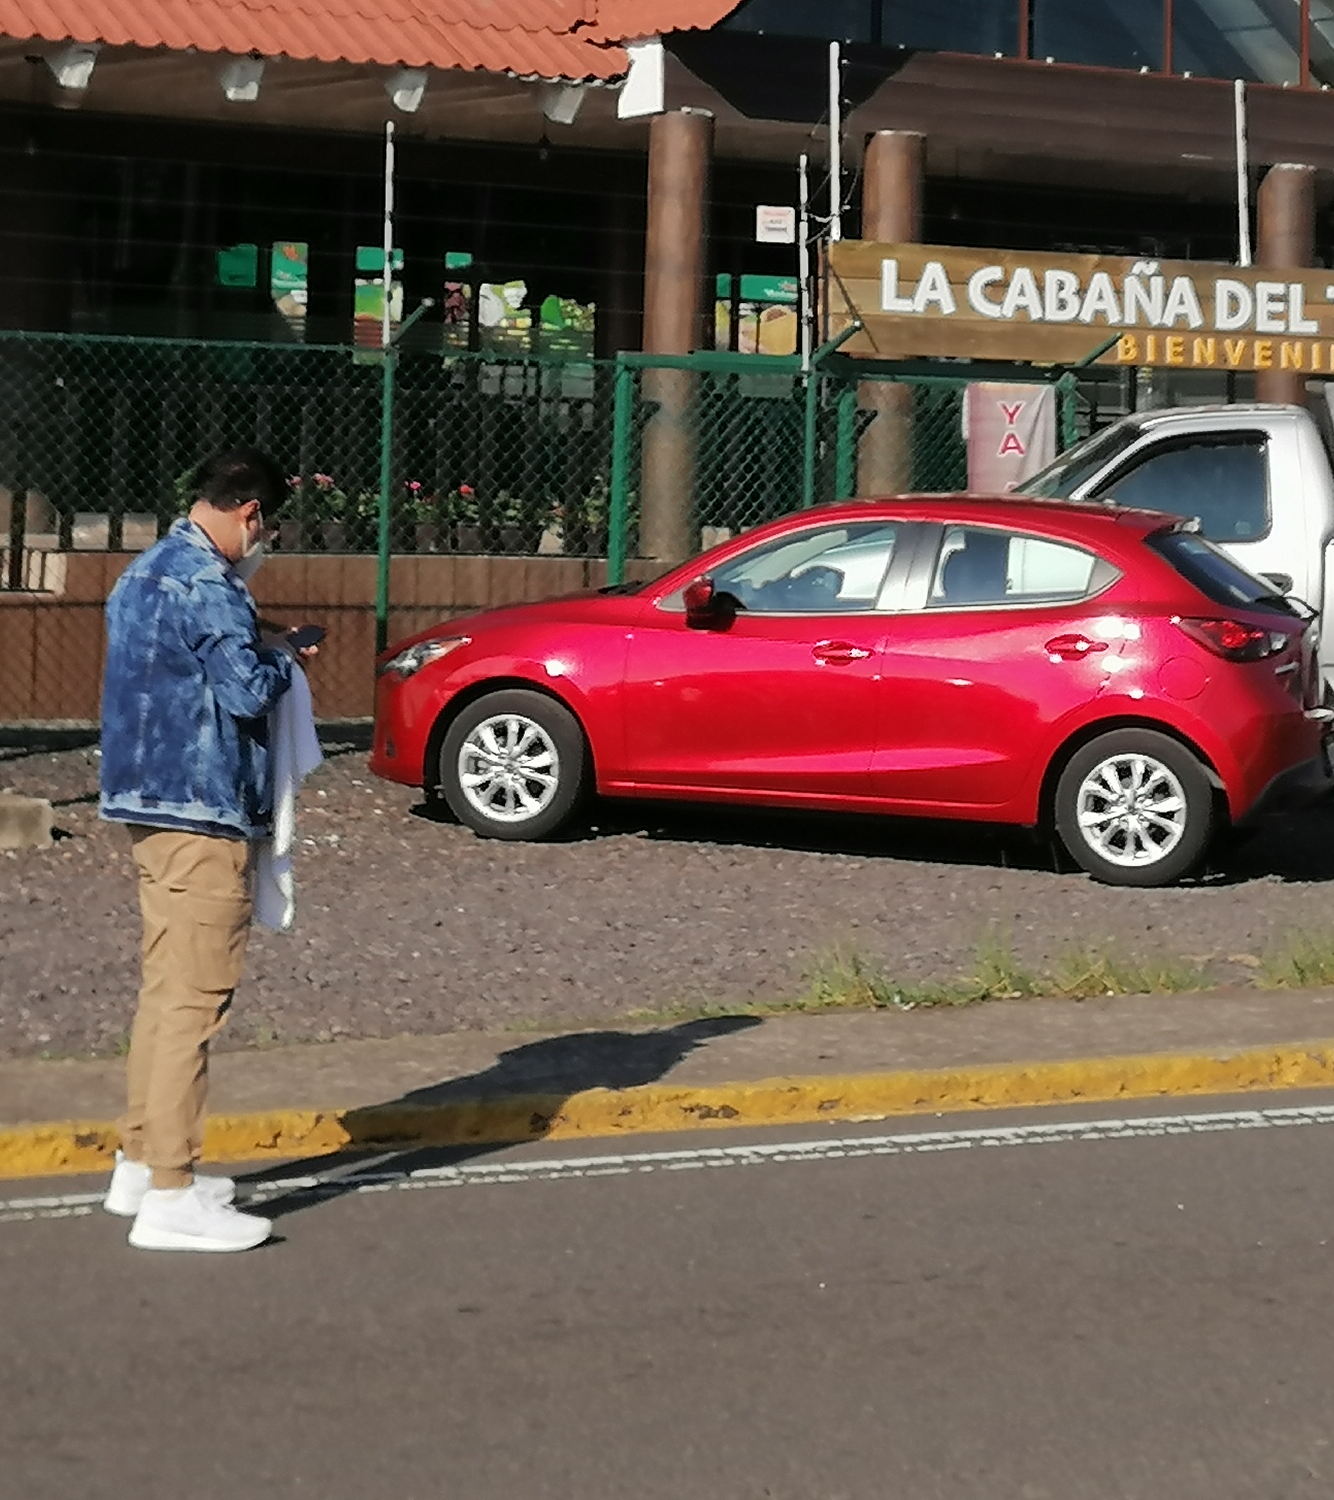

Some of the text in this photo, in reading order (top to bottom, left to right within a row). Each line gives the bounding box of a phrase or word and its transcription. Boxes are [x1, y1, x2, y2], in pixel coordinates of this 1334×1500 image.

[881, 258, 956, 315] LA
[967, 260, 1204, 330] CABAÑA
[1214, 277, 1319, 335] DEL
